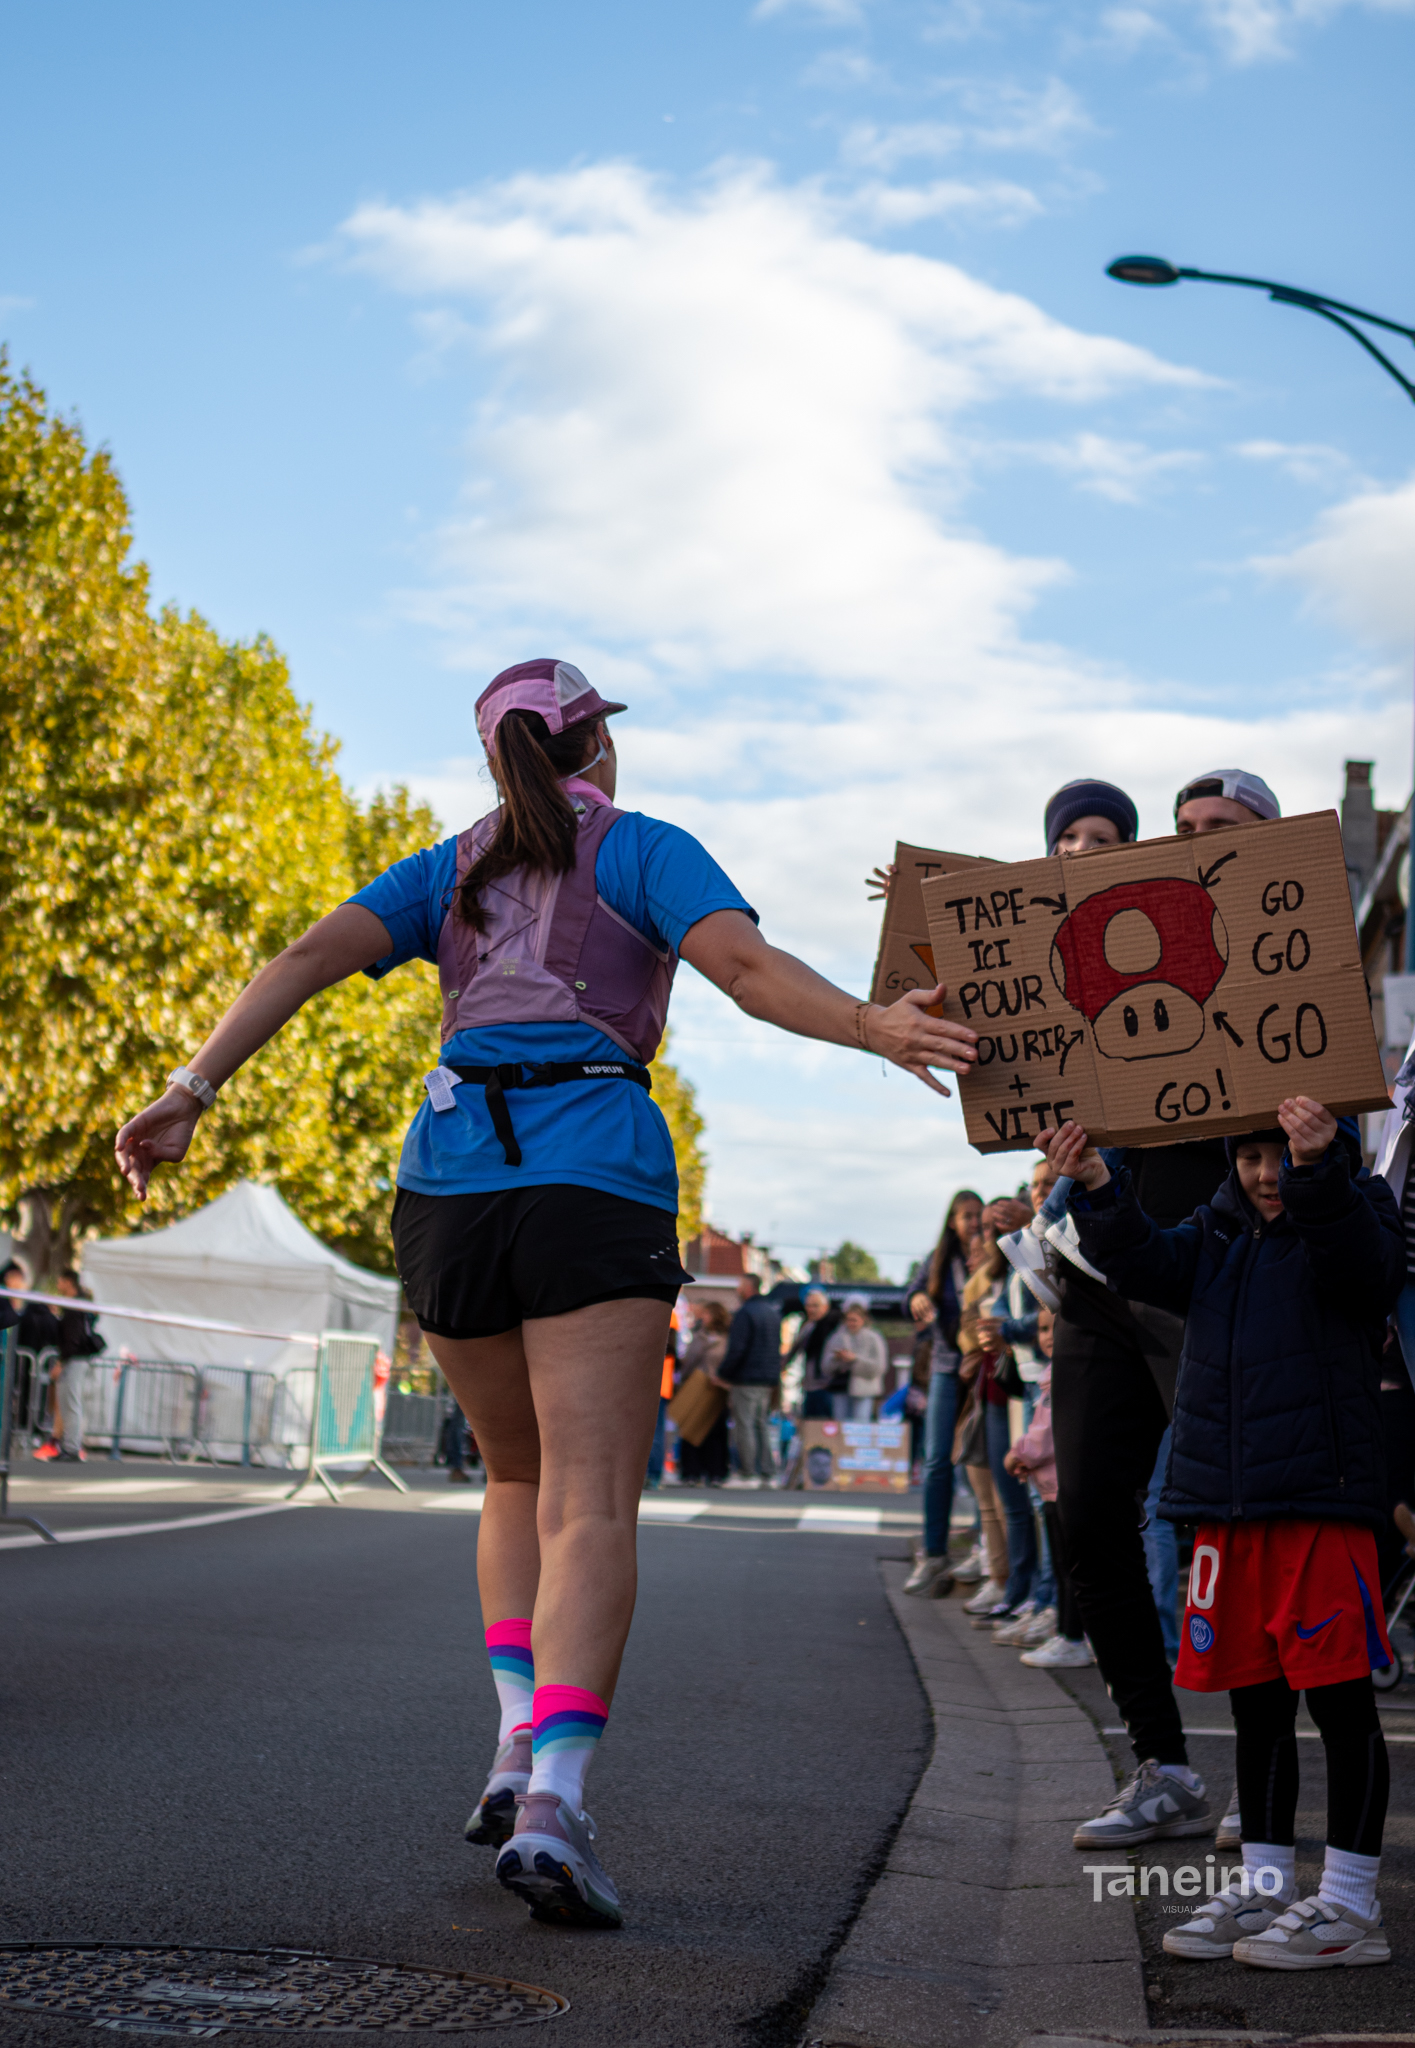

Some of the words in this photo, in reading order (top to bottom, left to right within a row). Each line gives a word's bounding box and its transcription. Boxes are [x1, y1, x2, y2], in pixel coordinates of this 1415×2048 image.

[945, 888, 1026, 934] TAPE
[1262, 880, 1304, 916] GO
[968, 939, 1012, 973] ICI
[1252, 929, 1310, 975] GO
[886, 971, 919, 991] GO
[959, 975, 1046, 1019] POUR
[952, 1024, 1069, 1066] OURIR
[1257, 1003, 1327, 1063] GO
[582, 1065, 625, 1075] KIPRUN
[1008, 1074, 1031, 1098] +
[1155, 1068, 1231, 1123] GO!
